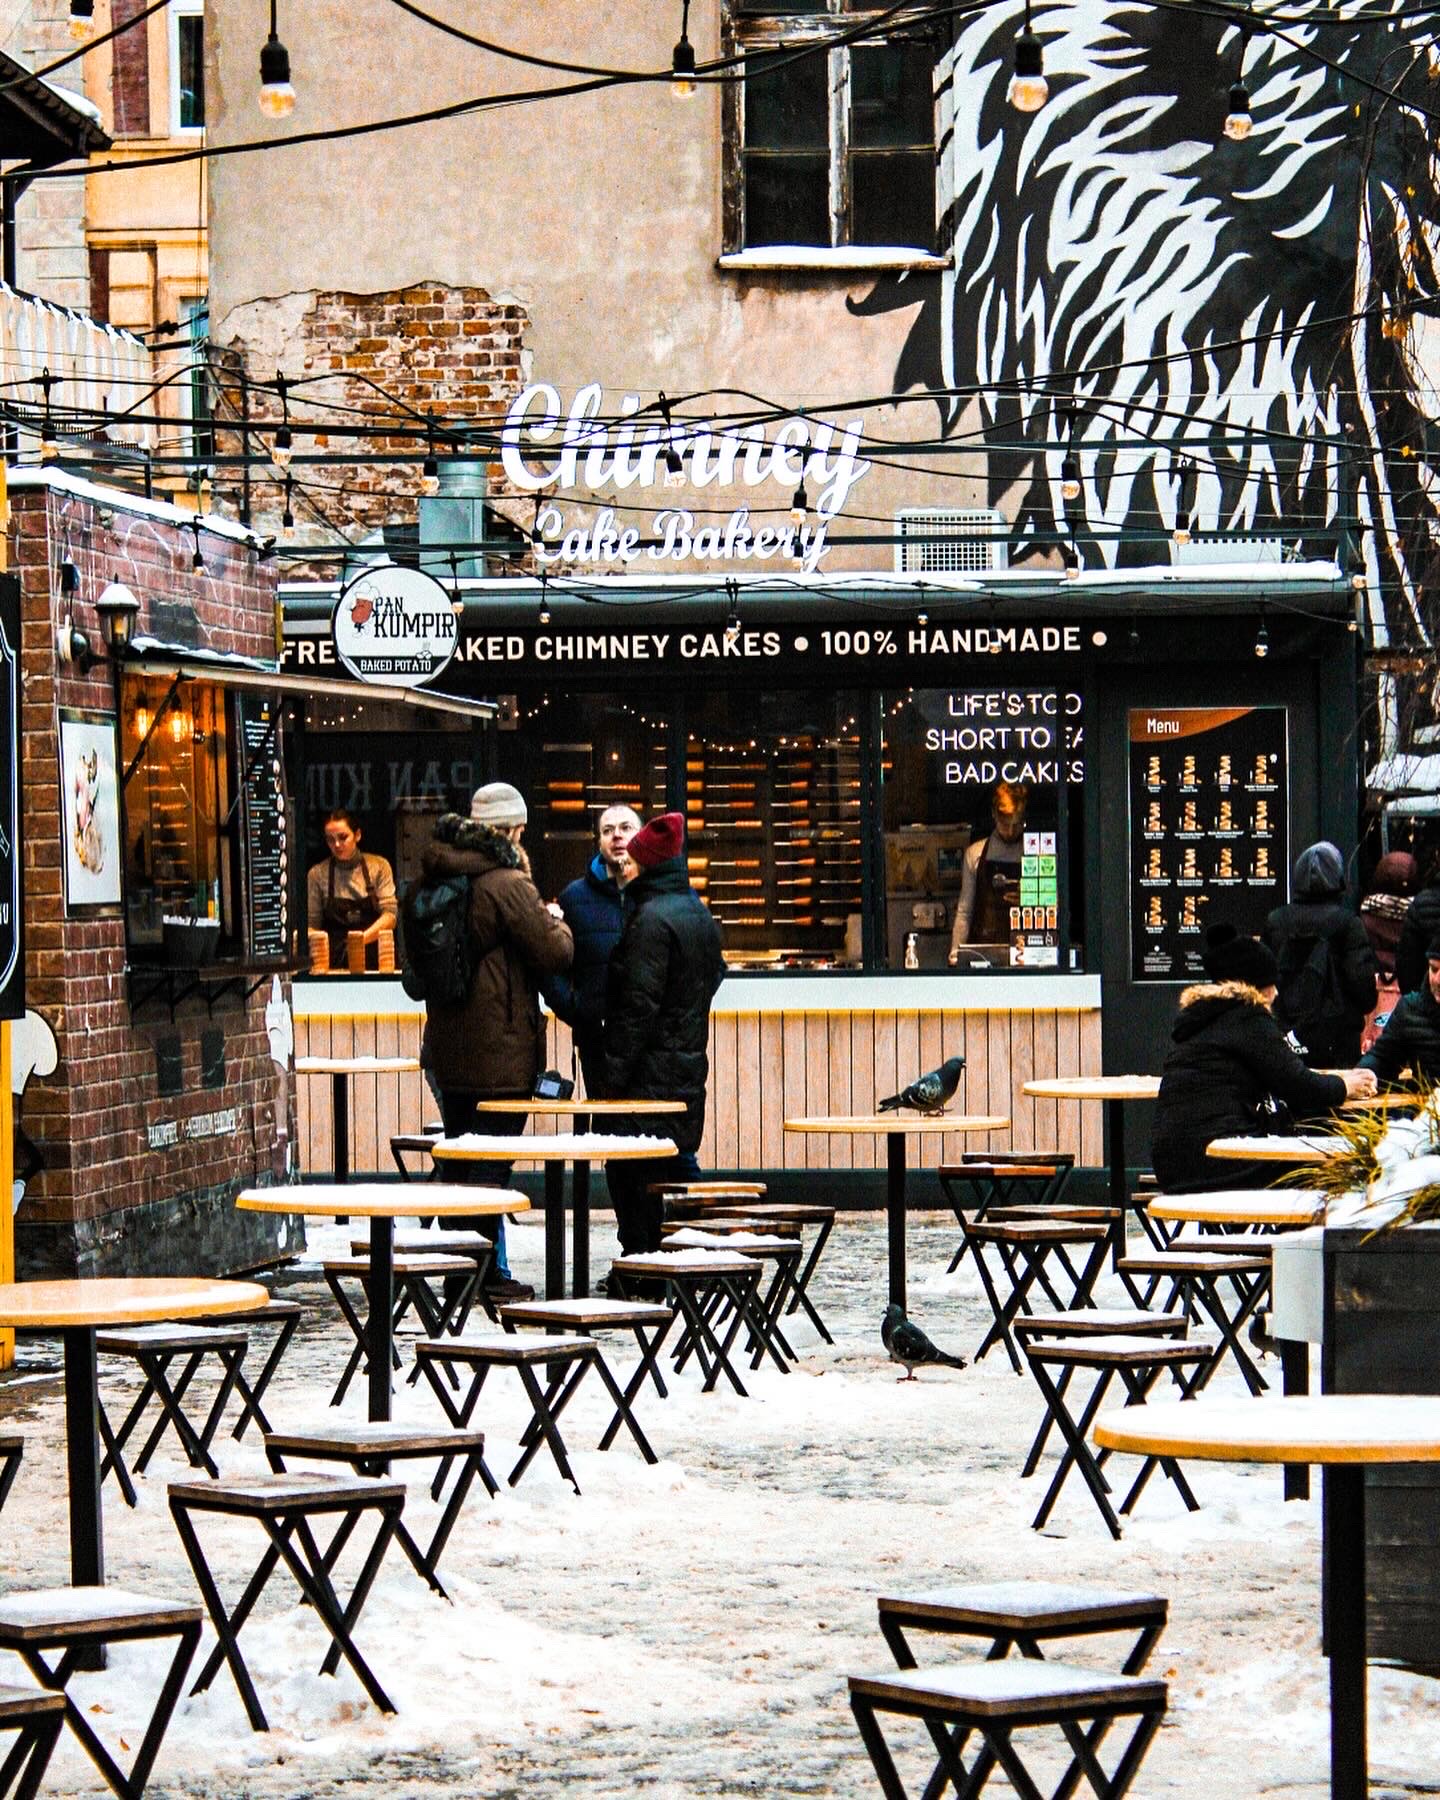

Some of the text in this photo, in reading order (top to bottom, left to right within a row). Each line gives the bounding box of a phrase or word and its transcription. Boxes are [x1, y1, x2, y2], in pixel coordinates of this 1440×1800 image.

[502, 383, 871, 520] Chimney
[534, 506, 832, 575] Cake Bakery
[375, 597, 403, 613] PAN
[374, 613, 454, 638] KUMPIR
[280, 641, 341, 664] FRE
[535, 635, 669, 660] CHIMNEY
[680, 632, 780, 657] CAKES
[821, 627, 1081, 654] 100% HANDMADE
[361, 660, 431, 671] BAKED POTATO
[949, 691, 1023, 716] LIFE'S
[925, 728, 1011, 750] SHORT
[1015, 727, 1050, 749] TO
[1147, 718, 1180, 734] Menu
[946, 762, 997, 783] BAD
